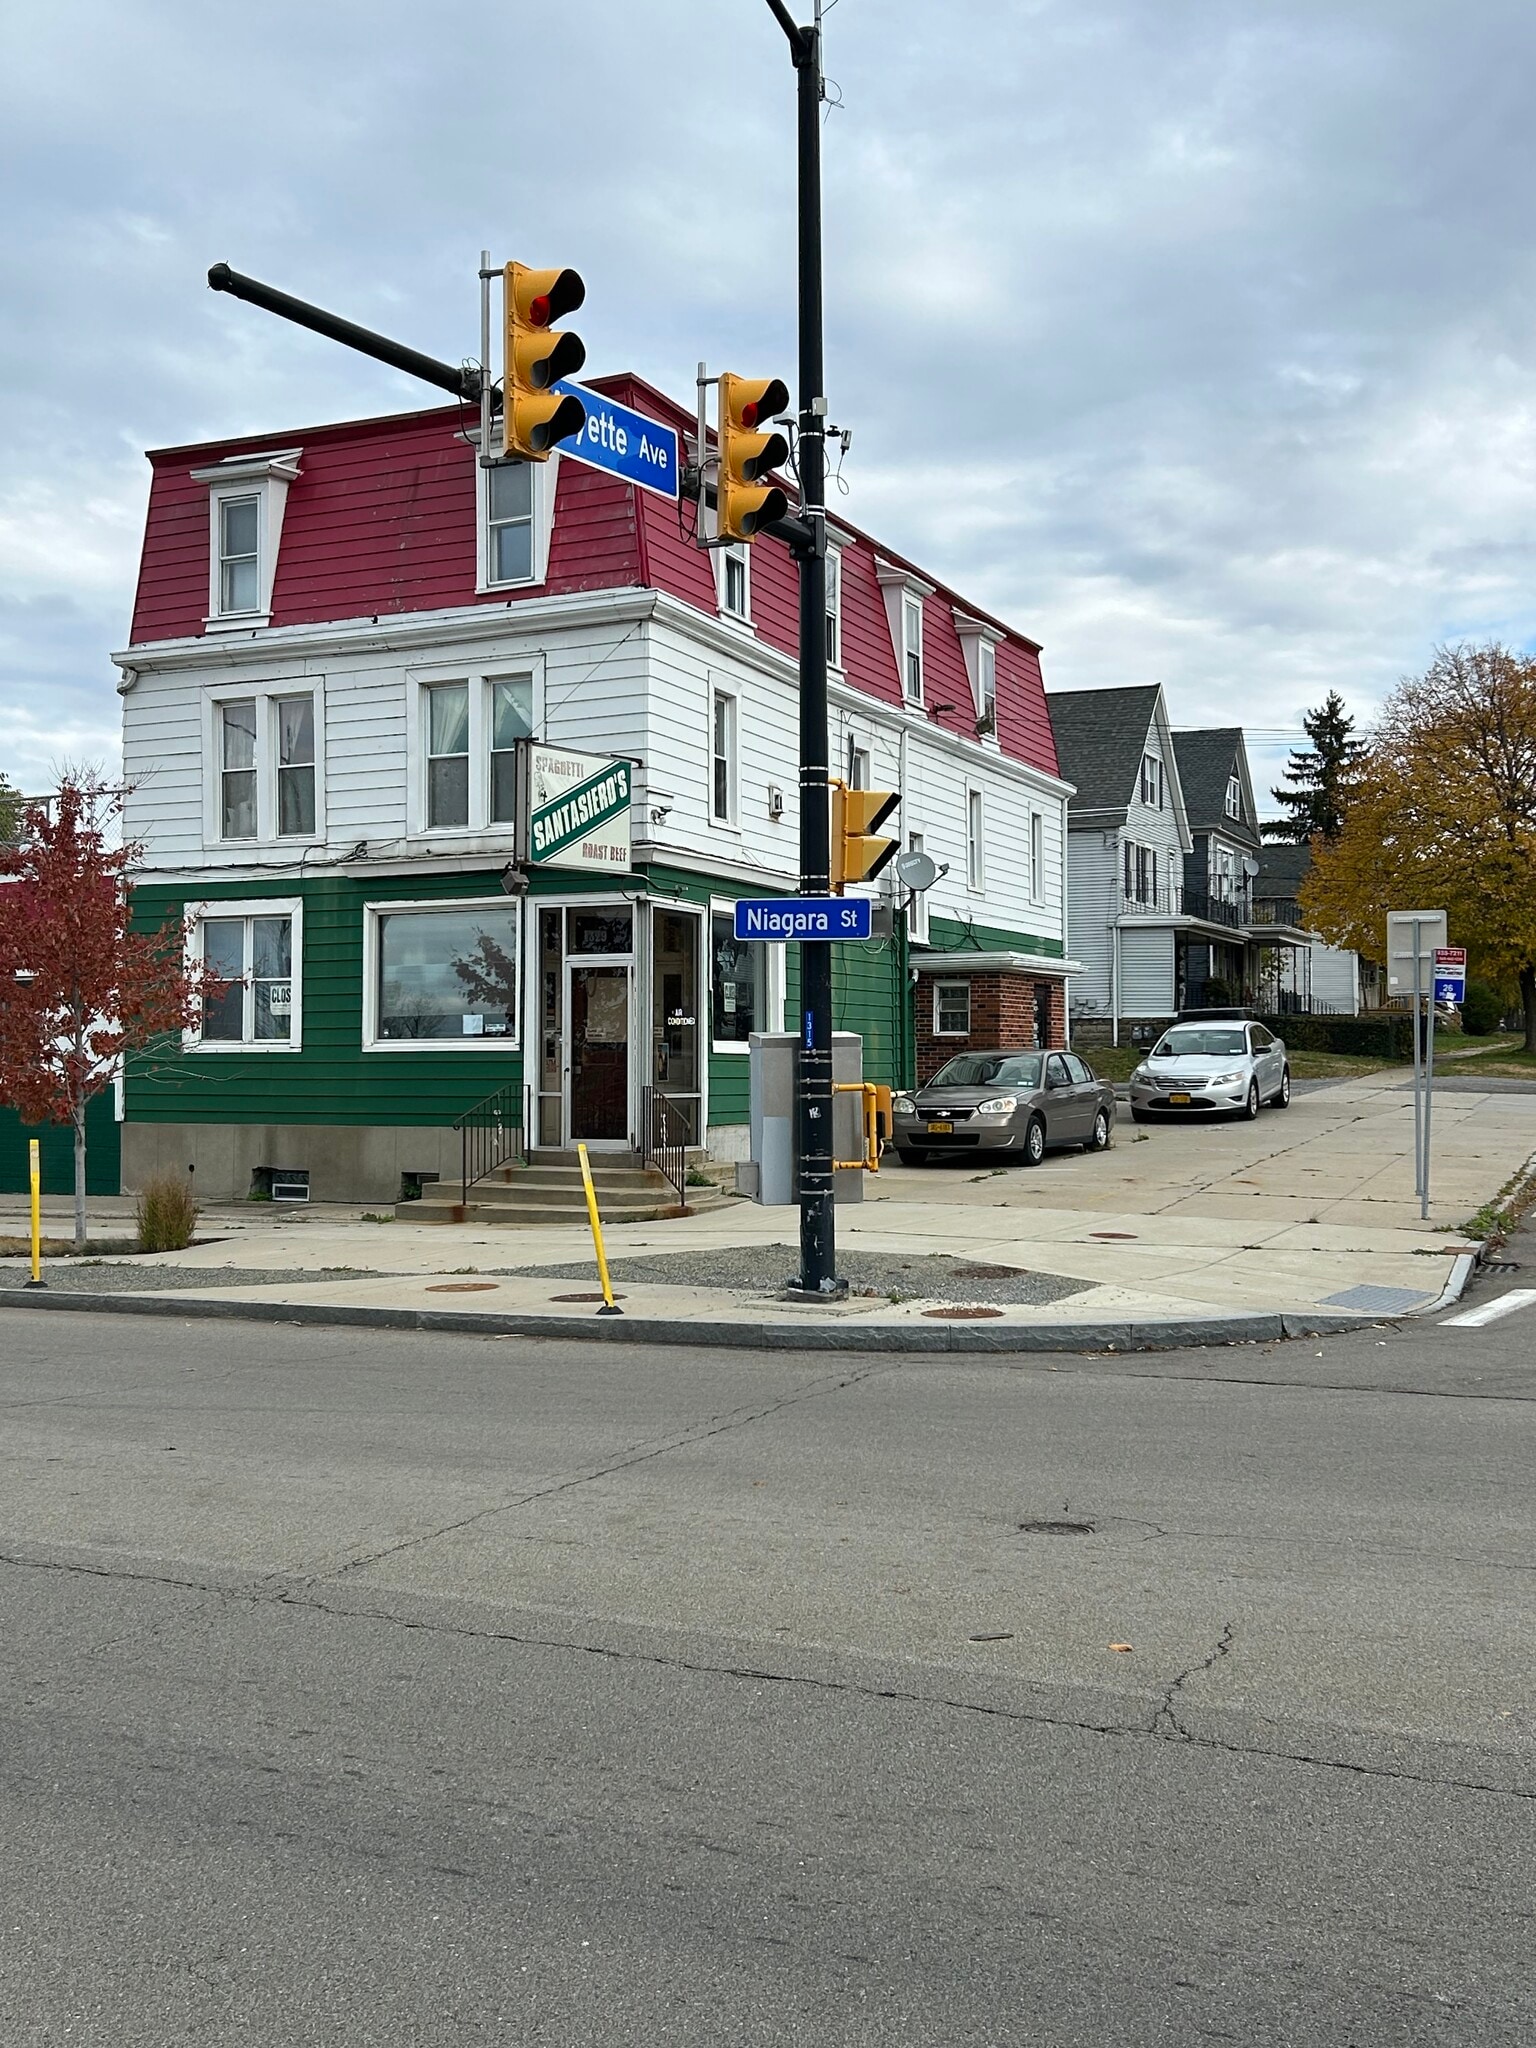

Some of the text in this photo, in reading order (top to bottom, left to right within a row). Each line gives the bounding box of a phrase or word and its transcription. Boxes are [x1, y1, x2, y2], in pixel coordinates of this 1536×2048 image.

[639, 434, 667, 469] Ave
[535, 755, 584, 778] SPAGHETTI
[533, 769, 628, 851] SANTASIERO'S
[582, 843, 627, 862] ROAST BEEF
[747, 908, 858, 938] Niagara St
[271, 988, 291, 1003] CLOS
[1442, 984, 1454, 992] 26
